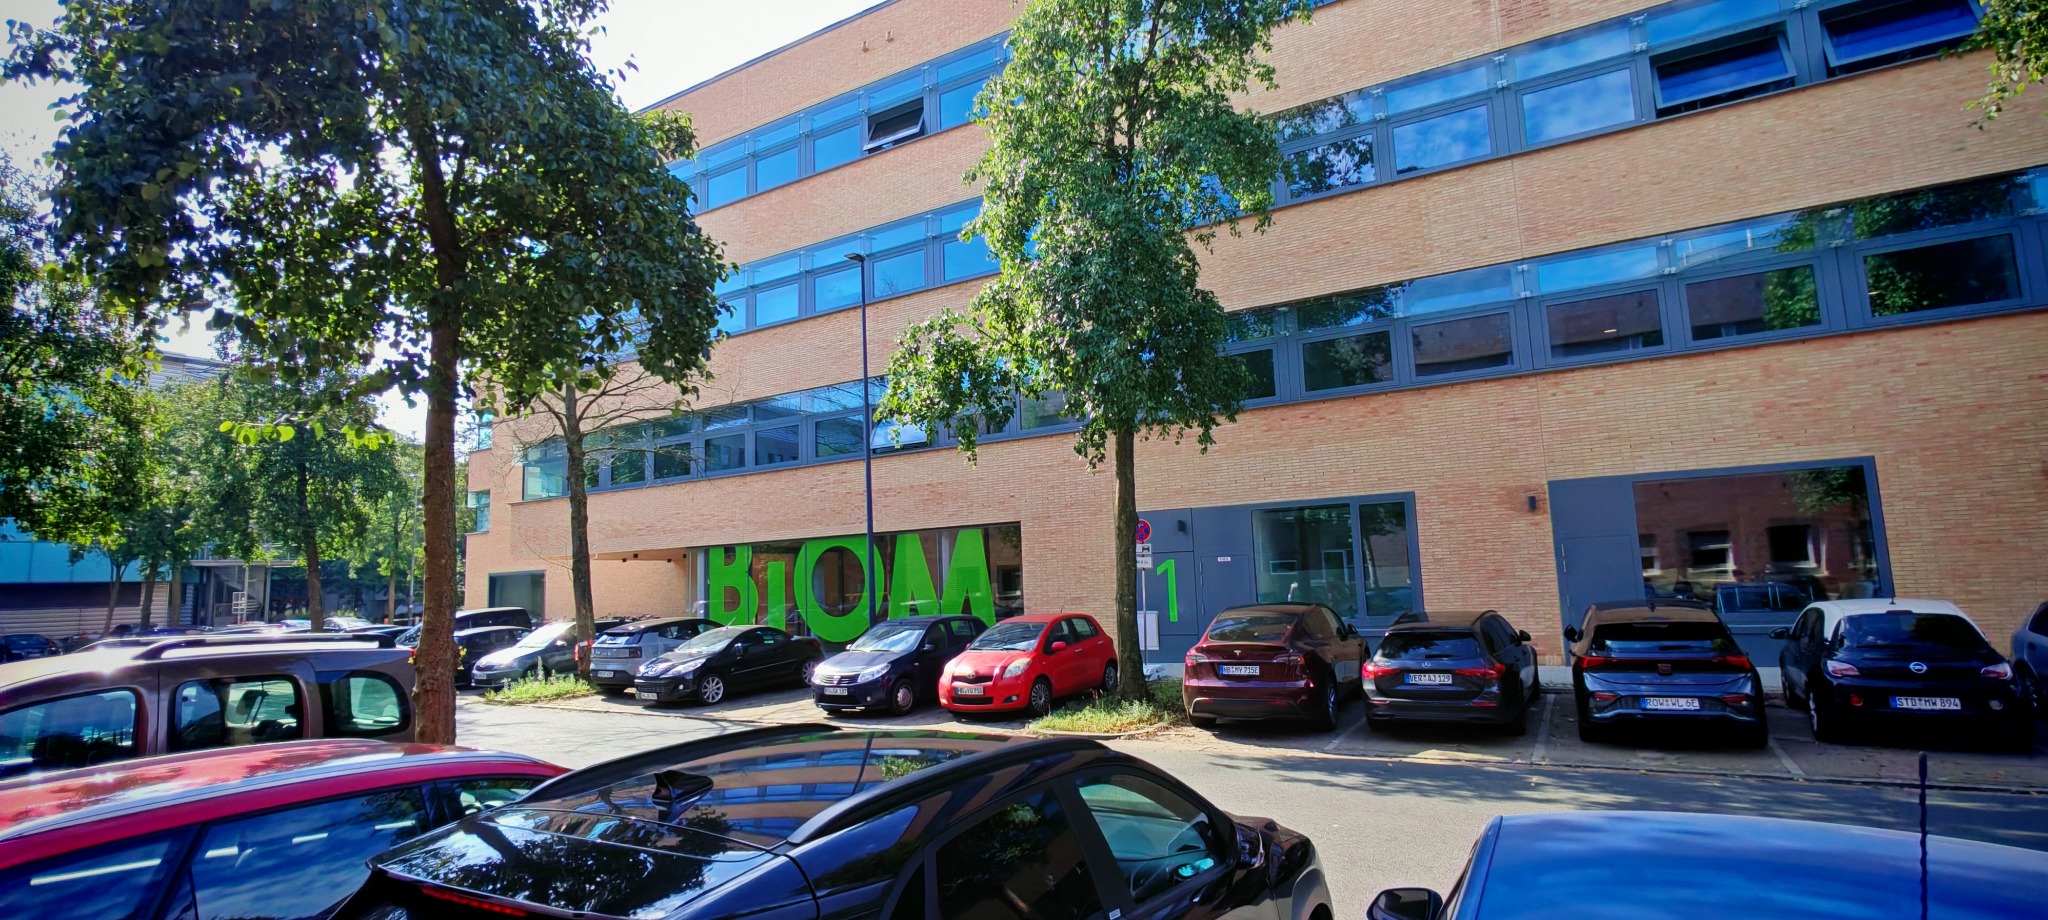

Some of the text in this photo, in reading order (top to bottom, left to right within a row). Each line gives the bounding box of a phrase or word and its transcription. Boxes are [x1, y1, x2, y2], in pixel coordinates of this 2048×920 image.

[1156, 559, 1179, 623] 1
[1409, 674, 1423, 682] VER
[1645, 698, 1699, 708] ROW WL 6E
[1897, 697, 1917, 707] STD
[1940, 698, 1959, 708] 894
